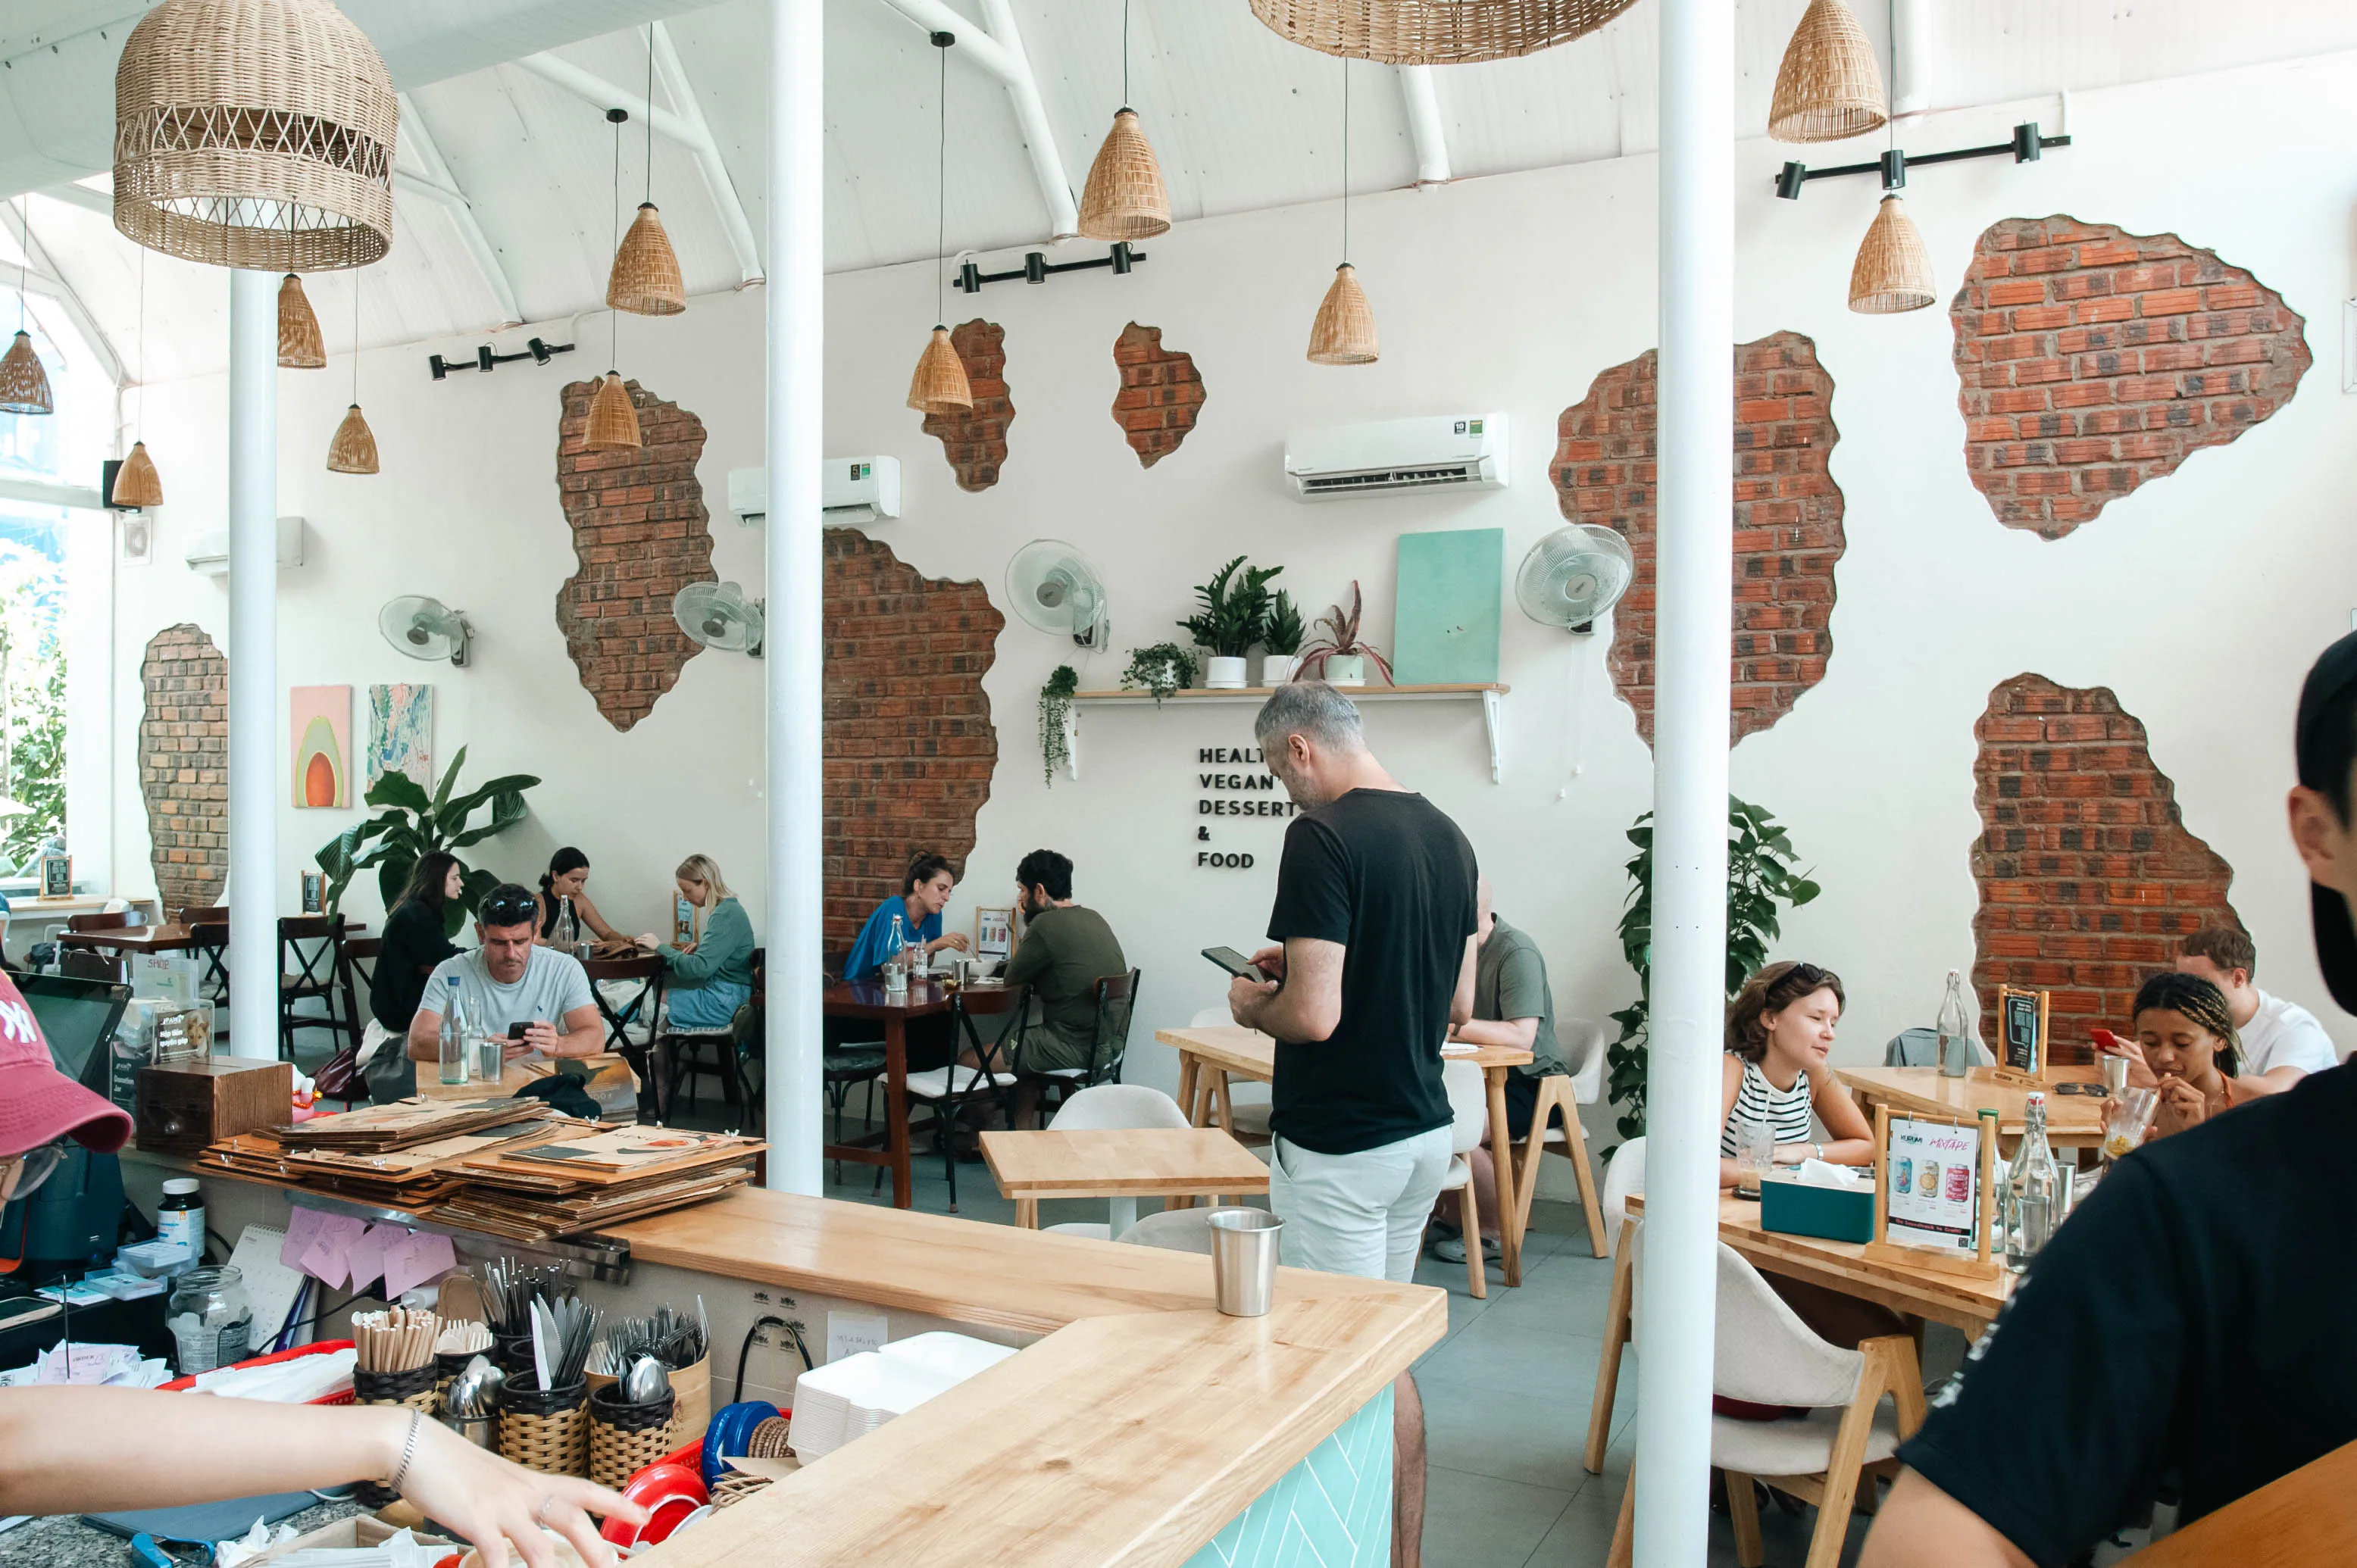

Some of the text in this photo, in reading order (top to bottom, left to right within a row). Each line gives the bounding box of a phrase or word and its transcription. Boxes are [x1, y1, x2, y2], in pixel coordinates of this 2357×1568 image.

[1199, 774, 1274, 790] VEGAN
[1197, 826, 1211, 842] &
[1198, 851, 1255, 869] FOOD
